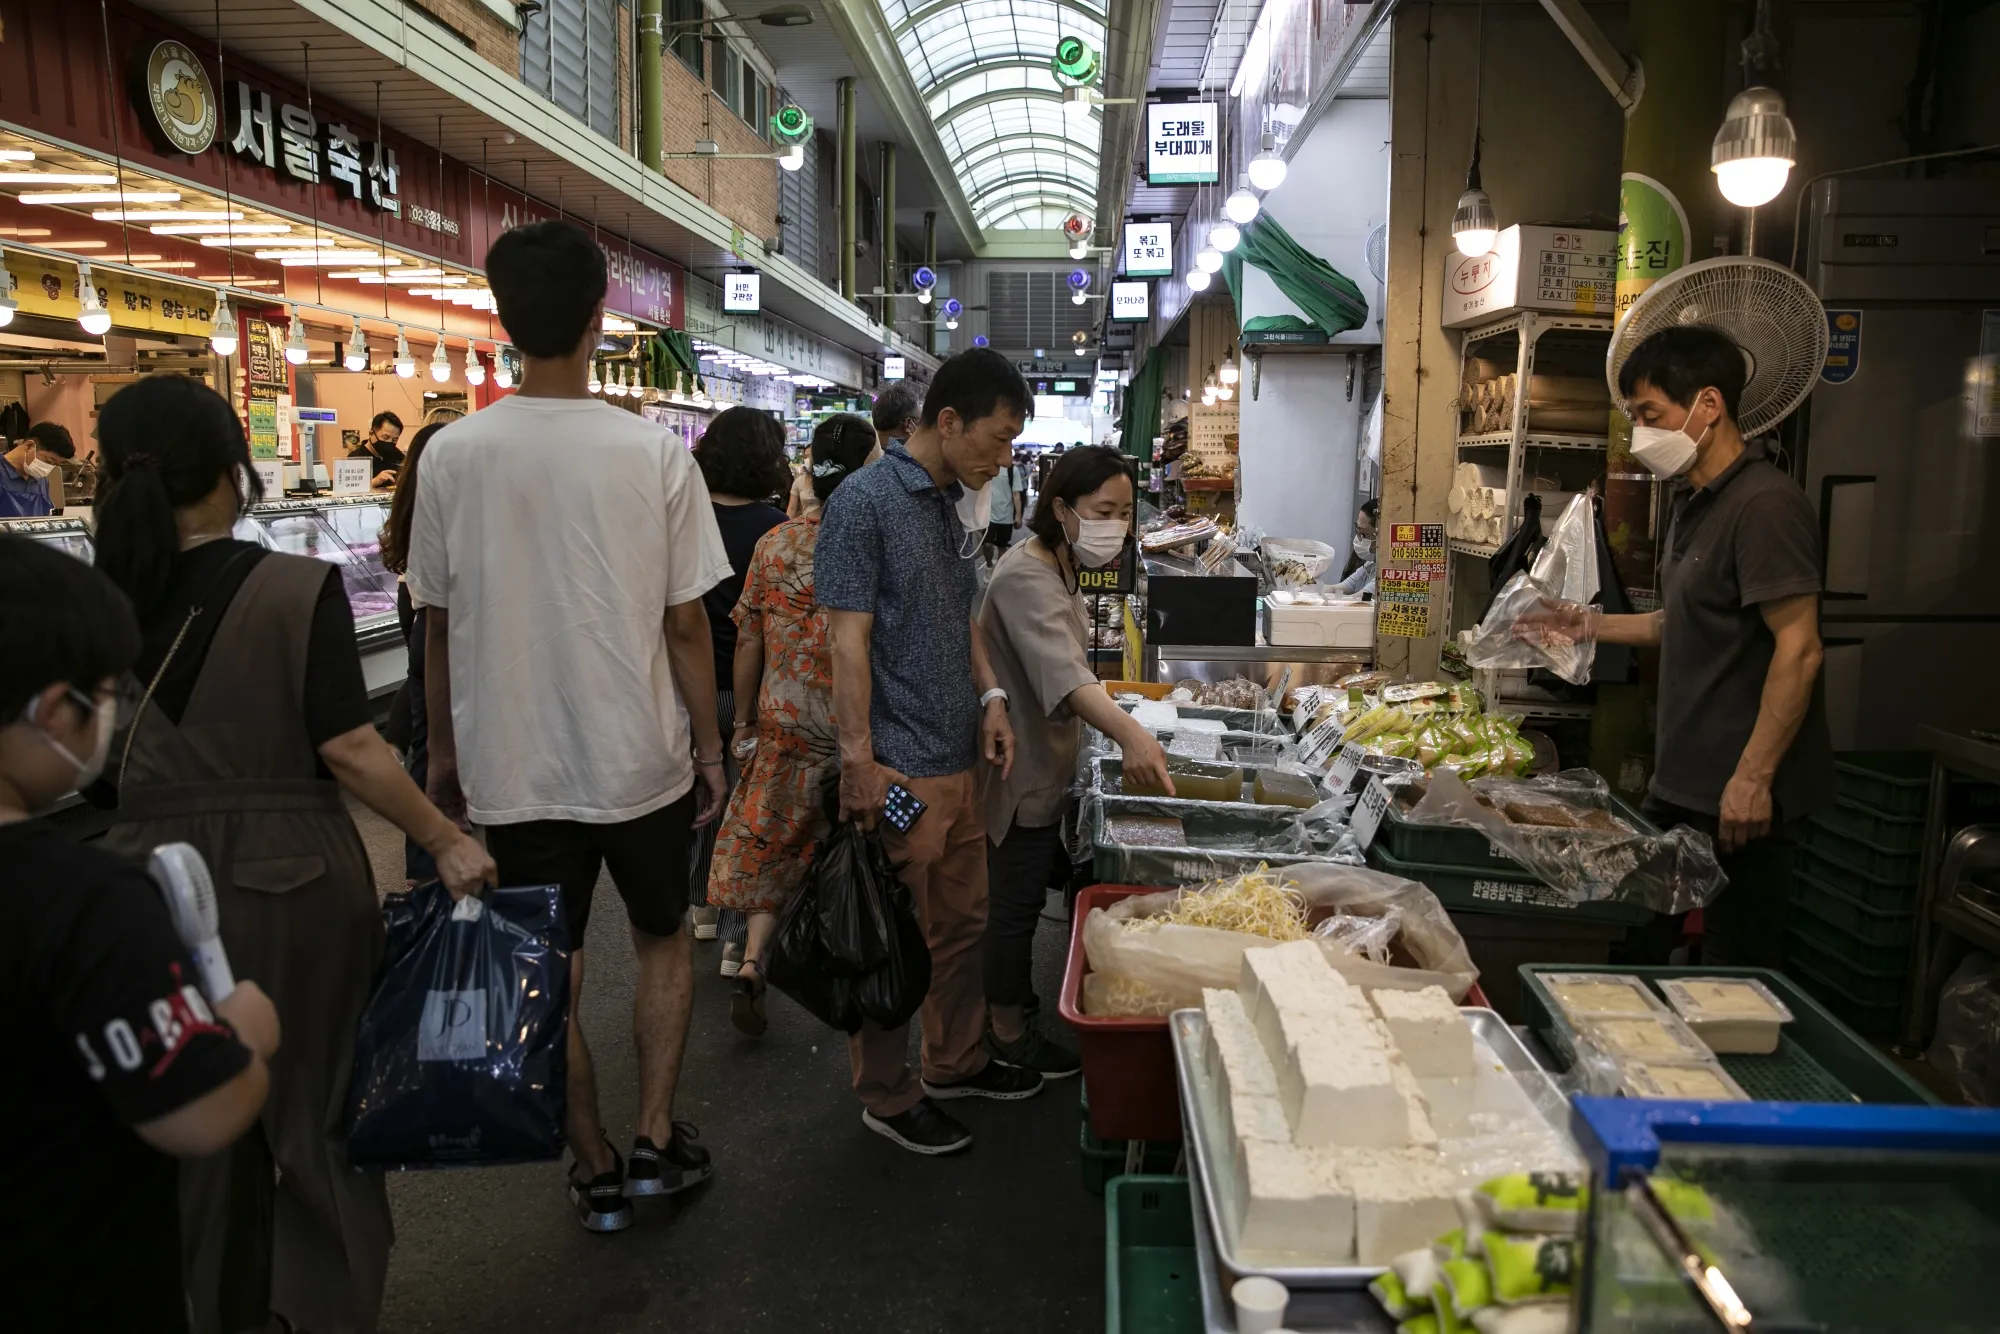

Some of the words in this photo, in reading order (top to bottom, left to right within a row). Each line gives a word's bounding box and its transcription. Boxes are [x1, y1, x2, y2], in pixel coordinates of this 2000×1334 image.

[1161, 120, 1206, 137] 도래울
[232, 80, 400, 212] 서울축산
[1155, 140, 1213, 156] 부대찌개
[1139, 235, 1158, 246] 볶고
[1133, 248, 1143, 259] 또
[1460, 259, 1491, 287] 누룽지
[650, 267, 672, 305] 가격
[735, 283, 749, 292] 서민
[1571, 280, 1591, 289] (043)
[731, 292, 753, 301] 구판장
[1116, 296, 1145, 305] 모자나라
[1542, 289, 1562, 299] FAX
[1570, 290, 1590, 301] (043)
[162, 298, 211, 322] 않습니다
[648, 304, 671, 324] 서울축산
[1391, 603, 1429, 616] 서울냉동
[1380, 612, 1428, 624] 357-3343
[1363, 781, 1387, 825] 도토리묵
[1472, 879, 1524, 903] 한결종합식품
